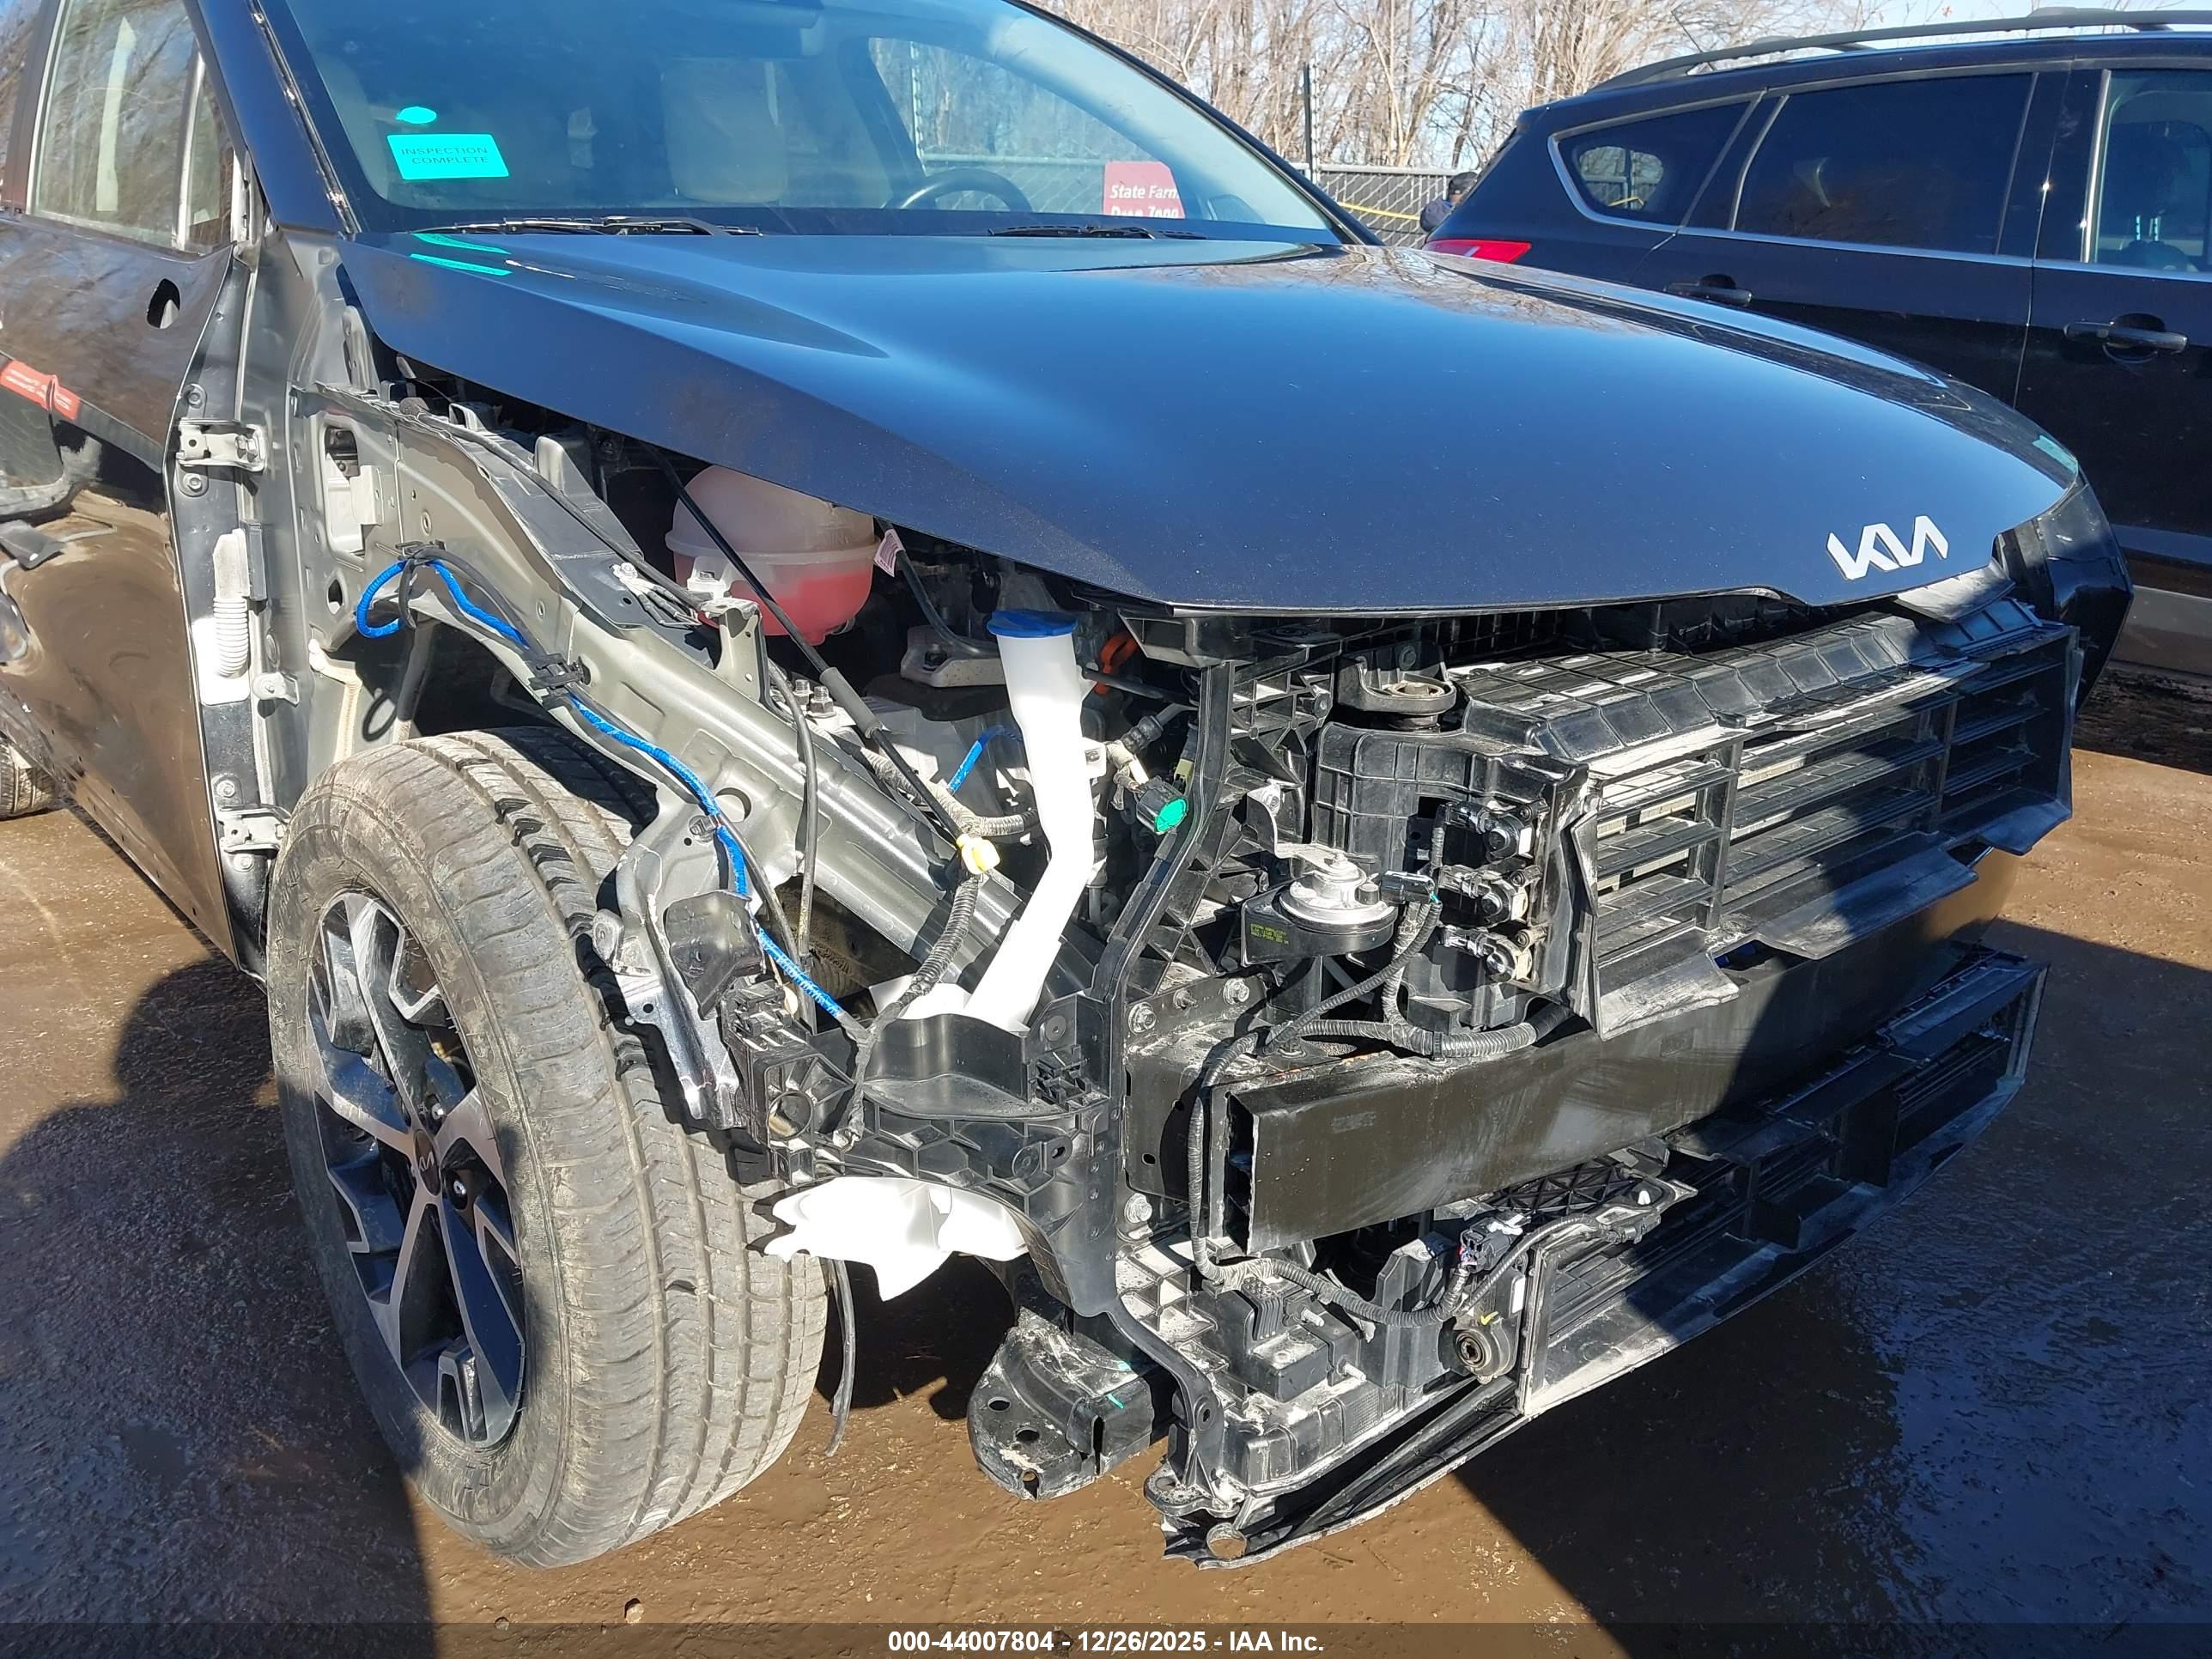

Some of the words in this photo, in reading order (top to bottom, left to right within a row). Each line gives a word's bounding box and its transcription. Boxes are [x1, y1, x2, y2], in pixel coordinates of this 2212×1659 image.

[401, 146, 488, 155] INSPECTION
[1109, 185, 1146, 199] State
[1826, 514, 1948, 580] KIA
